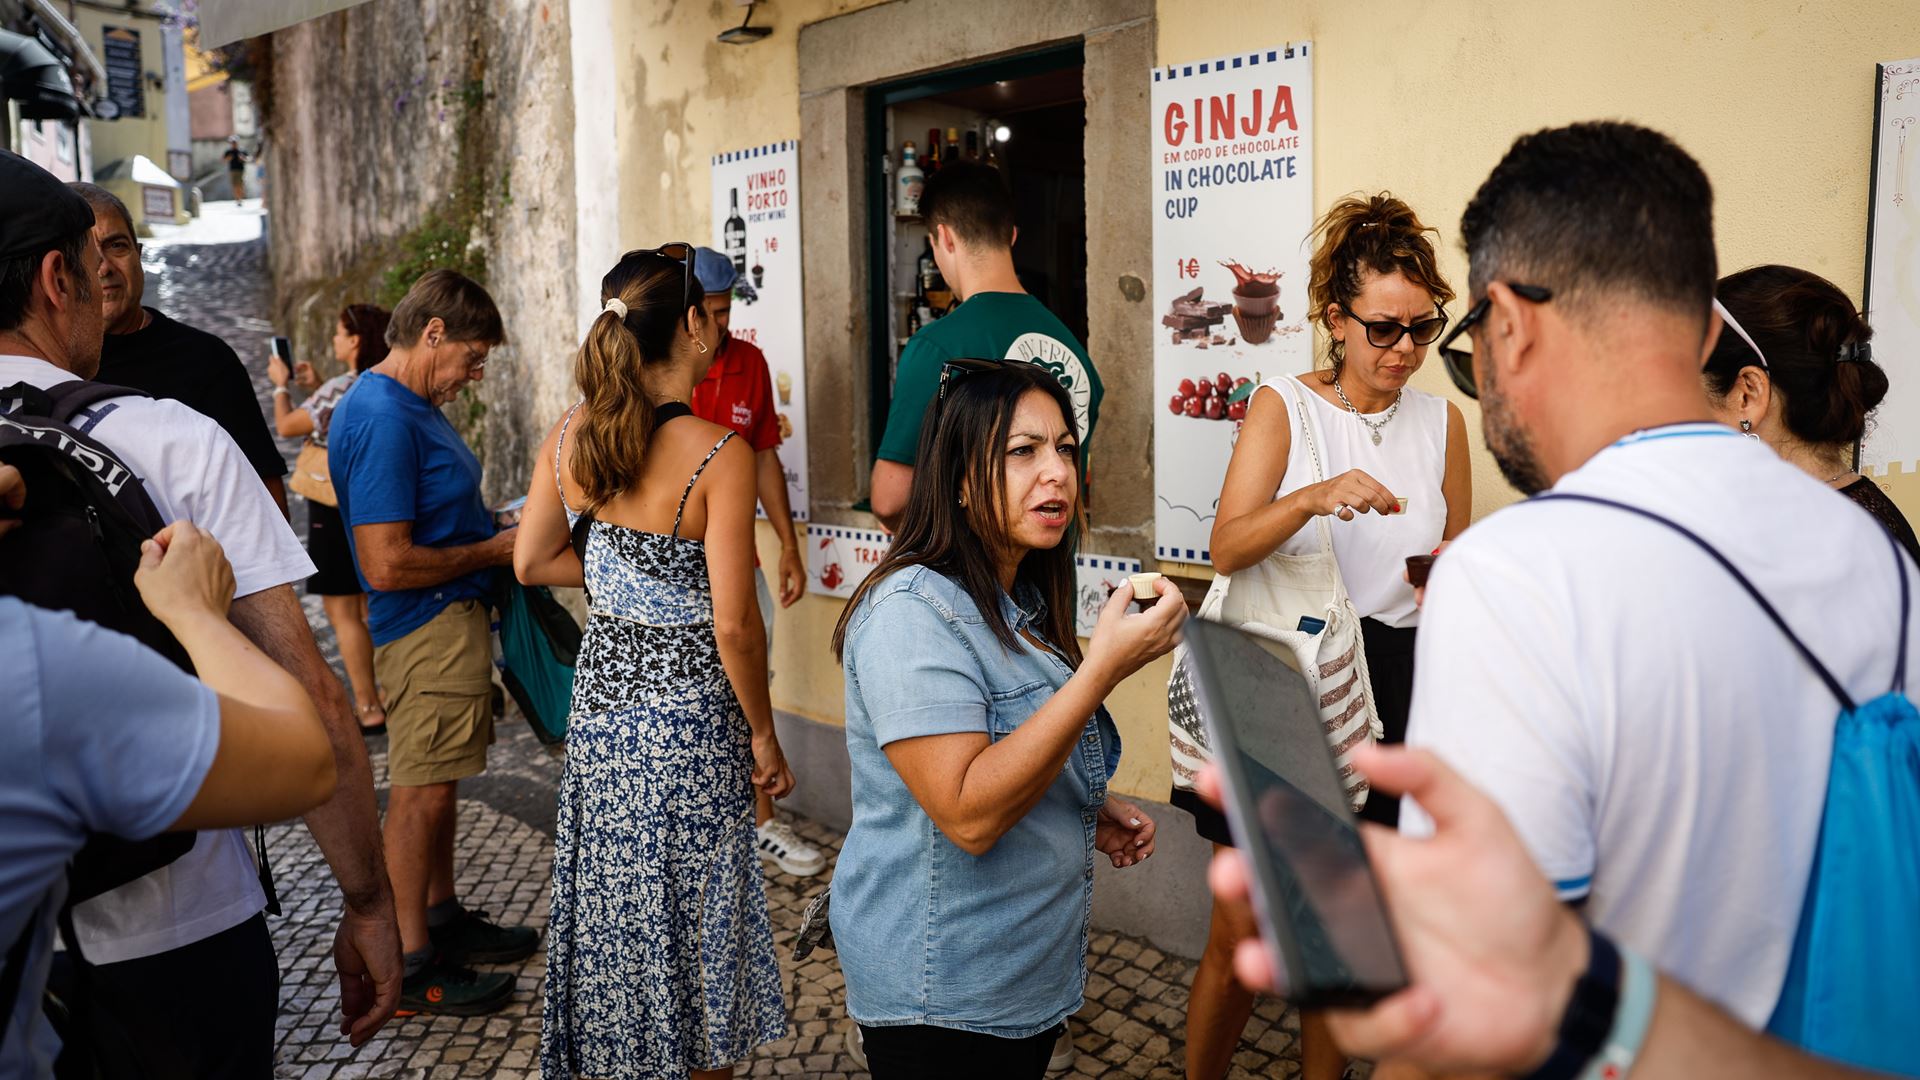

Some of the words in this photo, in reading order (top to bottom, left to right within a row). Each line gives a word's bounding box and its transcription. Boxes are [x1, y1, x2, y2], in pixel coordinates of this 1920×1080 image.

[1164, 85, 1298, 147] GINJA
[1164, 151, 1181, 164] EM
[1184, 148, 1212, 161] COPO
[1216, 145, 1229, 158] DE
[1232, 136, 1299, 155] CHOCOLATE
[747, 168, 786, 191] VINHO
[1165, 170, 1182, 191] IN
[1188, 156, 1297, 188] CHOCOLATE
[747, 189, 788, 211] PORTO
[1165, 196, 1198, 219] CUP
[748, 212, 766, 223] PORT
[768, 209, 786, 221] WINE
[764, 236, 779, 253] 1€
[1177, 257, 1200, 279] 1€
